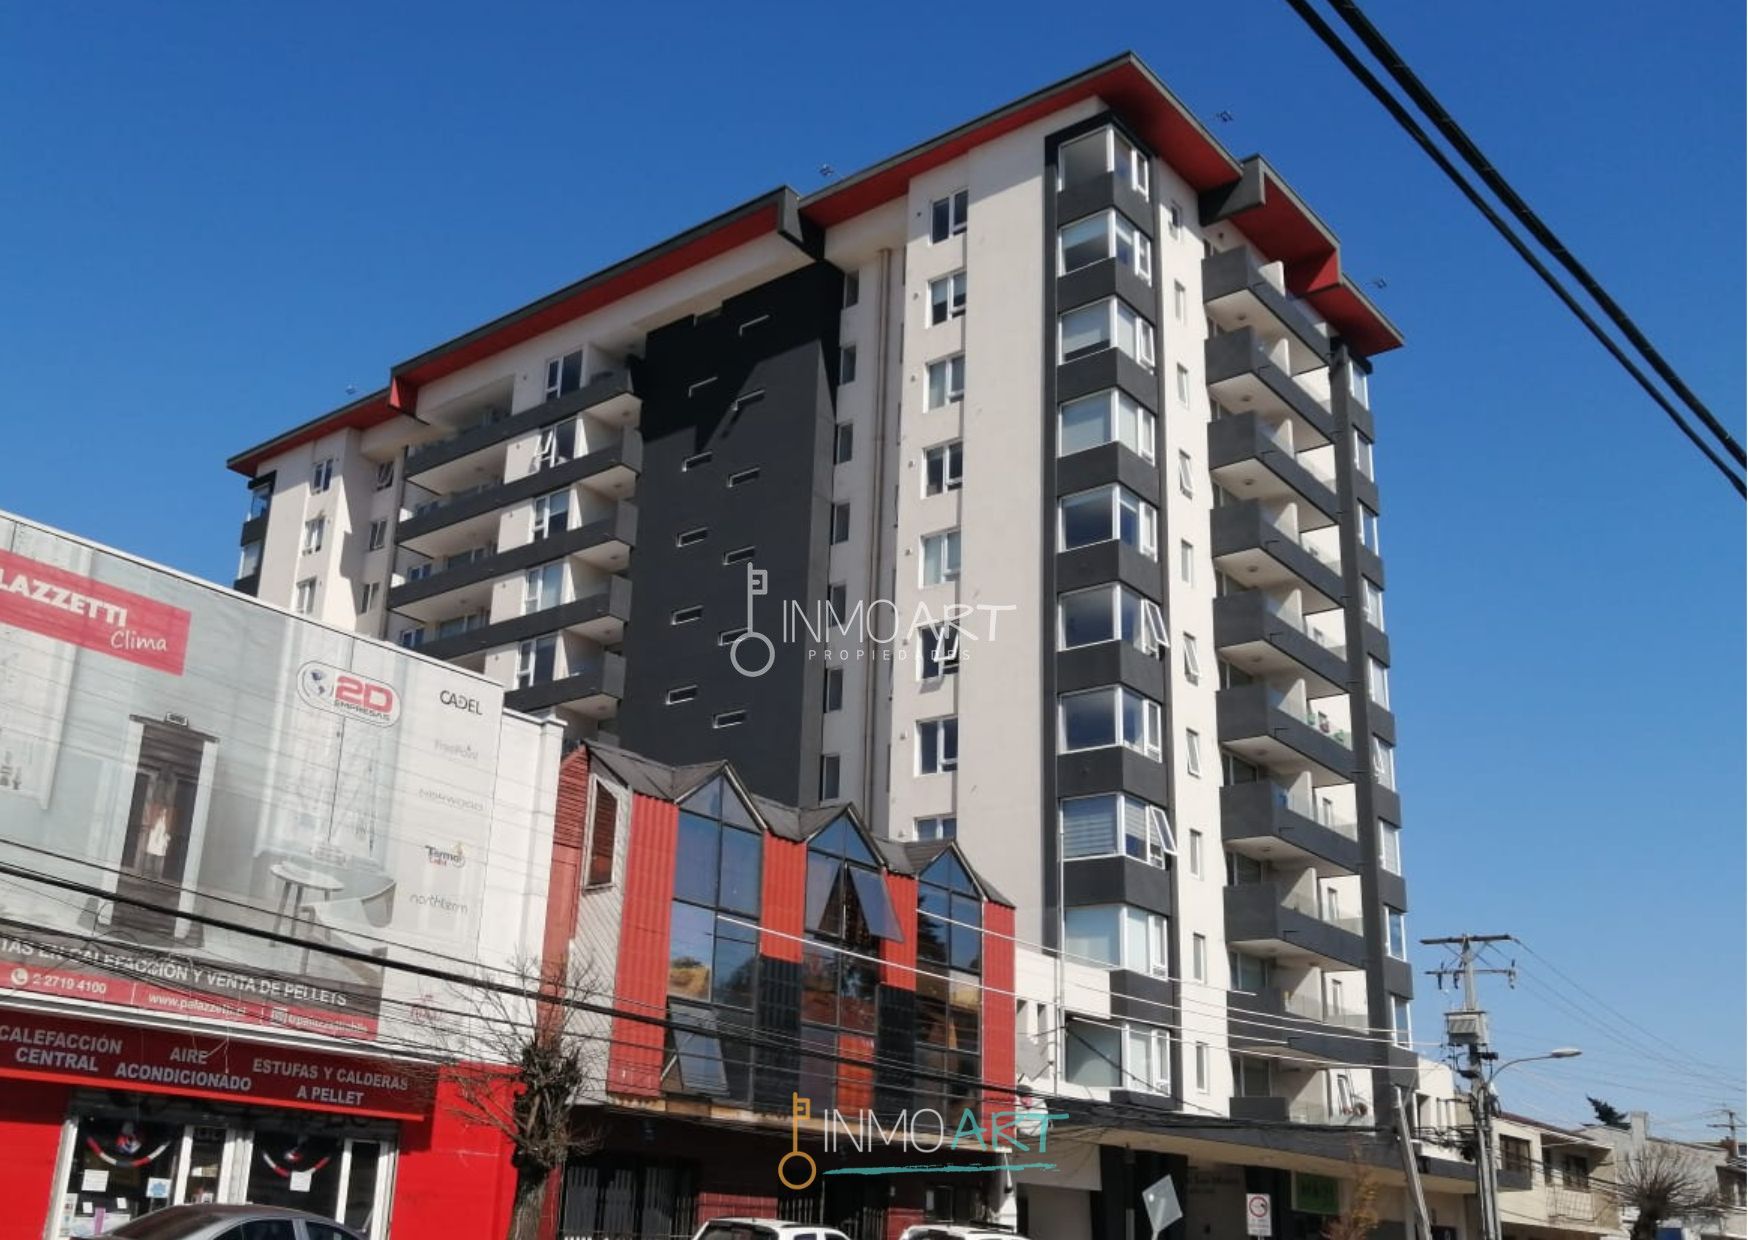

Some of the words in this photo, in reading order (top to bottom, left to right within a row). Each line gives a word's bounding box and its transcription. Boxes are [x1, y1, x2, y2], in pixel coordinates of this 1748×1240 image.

[110, 630, 168, 651] Clima
[335, 675, 393, 713] 2D
[440, 690, 483, 715] CADEL
[44, 976, 74, 990] 2719
[78, 980, 107, 994] 4100
[193, 969, 206, 984] Y
[207, 970, 256, 993] VENTA
[258, 979, 281, 995] DE
[284, 983, 347, 1006] PELLETS
[0, 1025, 123, 1054] CALEFACCIÓN
[16, 1047, 99, 1072] CENTRAL
[170, 1047, 209, 1065] AIRE
[115, 1063, 252, 1091] ACONDICIONADO
[252, 1059, 318, 1080] ESTUFAS
[323, 1067, 333, 1081] Y
[336, 1069, 409, 1091] CALDERAS
[297, 1085, 307, 1100] A
[311, 1087, 364, 1106] PELLET
